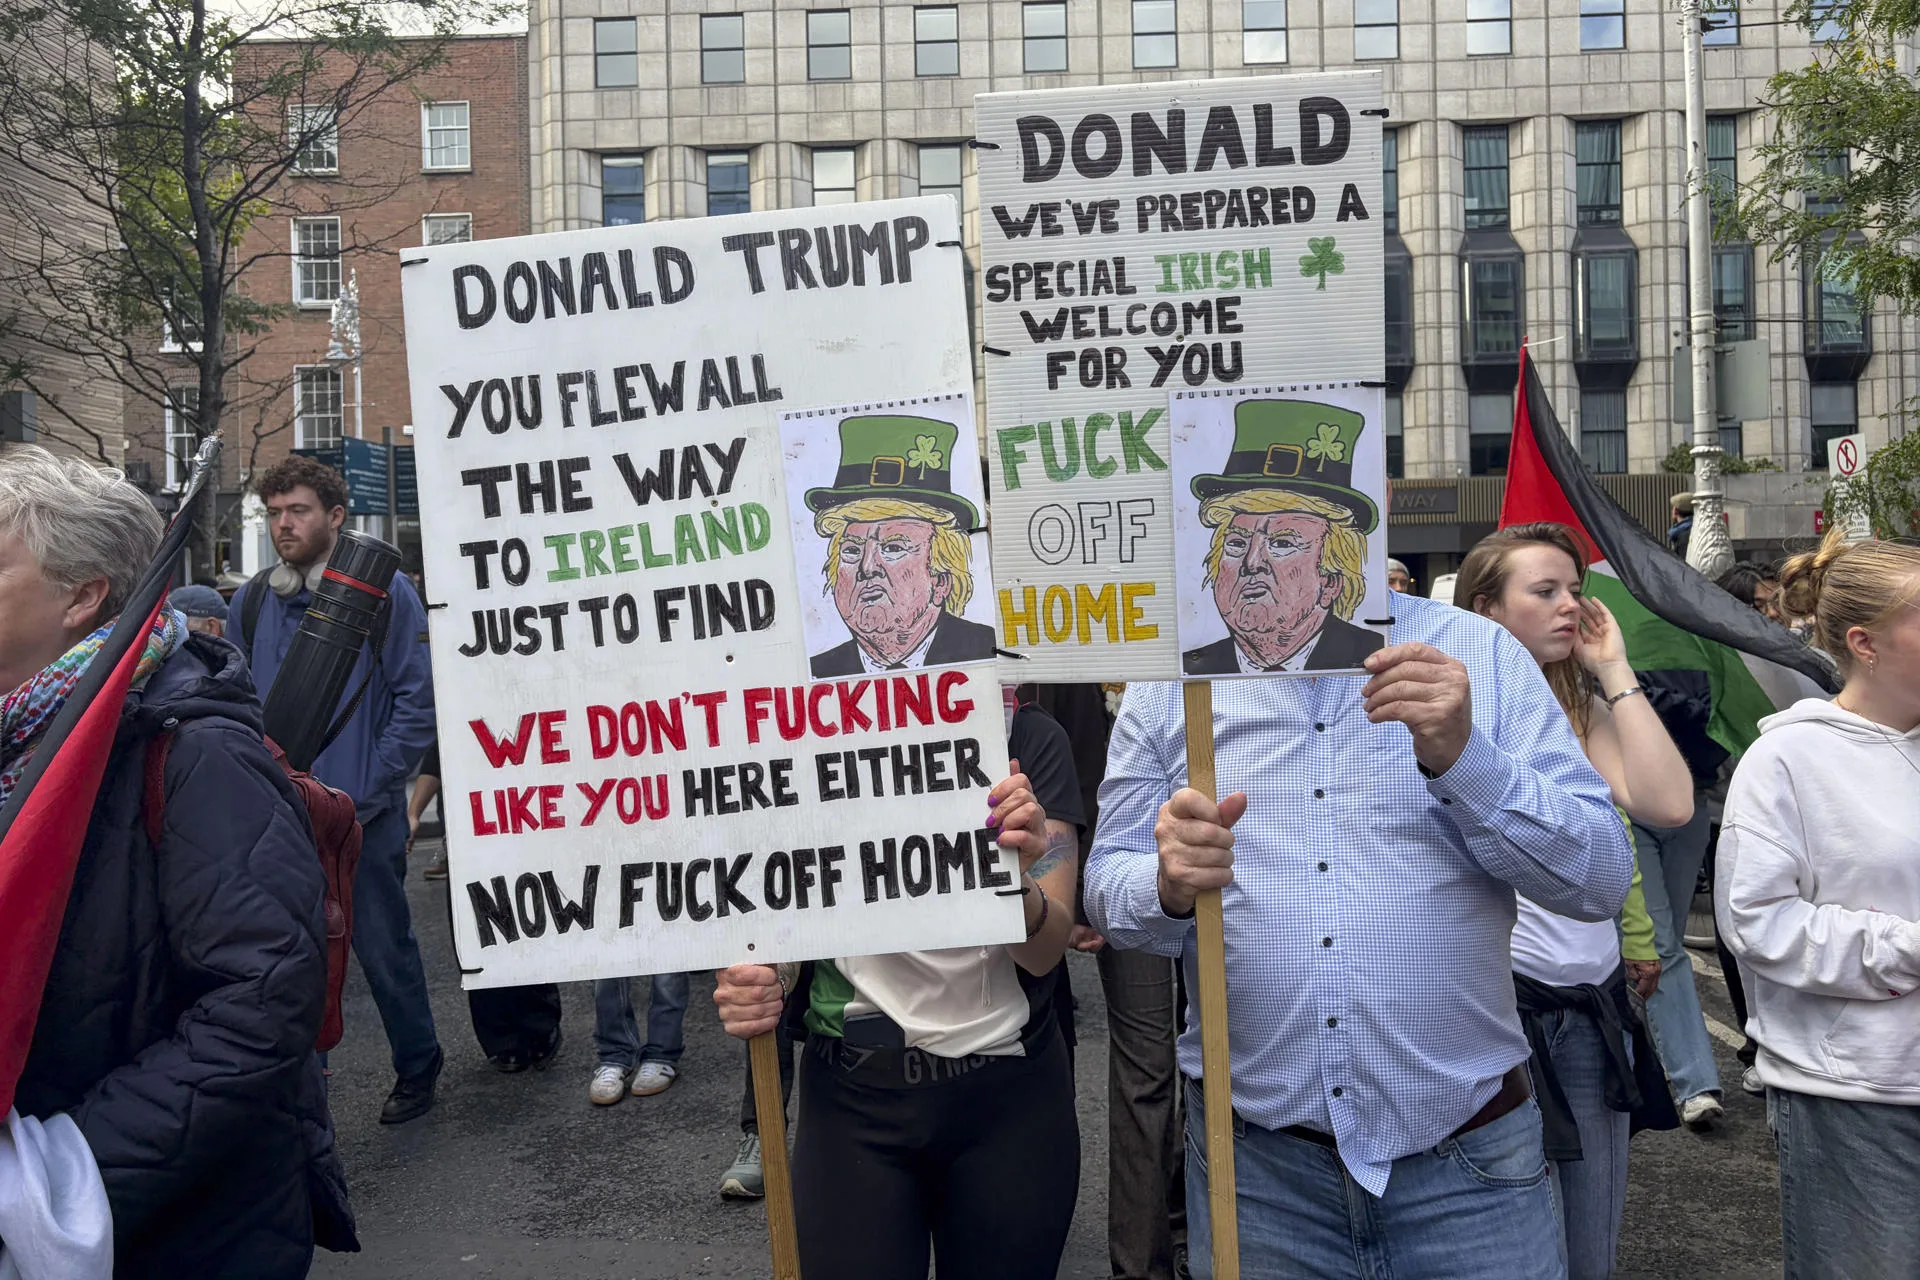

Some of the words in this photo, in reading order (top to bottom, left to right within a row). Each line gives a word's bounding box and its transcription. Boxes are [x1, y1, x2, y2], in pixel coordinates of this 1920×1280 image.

[1016, 96, 1351, 183] DONALD
[991, 199, 1120, 240] WE'VE
[1136, 185, 1316, 234] PREPARED
[1336, 183, 1370, 222] A
[452, 245, 696, 330] DONALD
[722, 216, 930, 294] TRUMP
[985, 256, 1137, 302] SPECIAL
[1153, 247, 1272, 293] IRISH
[1019, 296, 1244, 344] WELCOME
[439, 375, 542, 439] YOU
[558, 360, 685, 428] FLEW
[697, 353, 783, 411] ALL
[1046, 345, 1132, 390] FOR
[1144, 340, 1244, 388] YOU
[461, 456, 592, 519] THE
[613, 438, 747, 506] WAY
[996, 407, 1168, 491] FUCK
[459, 537, 531, 590] TO
[544, 502, 772, 582] IRELAND
[1028, 498, 1155, 565] OFF
[458, 602, 569, 658] JUST
[578, 596, 639, 648] TO
[654, 579, 775, 642] FIND
[998, 582, 1159, 648] HOME
[469, 710, 570, 768] WE
[587, 690, 727, 760] DON'T
[743, 670, 974, 744] FUCKING
[469, 785, 565, 836] LIKE
[577, 773, 669, 827] YOU
[683, 759, 799, 817] HERE
[816, 737, 992, 802] EITHER
[467, 864, 600, 949] NOW
[619, 851, 756, 928] FUCK
[764, 845, 846, 911] OFF
[859, 827, 1013, 903] HOME
